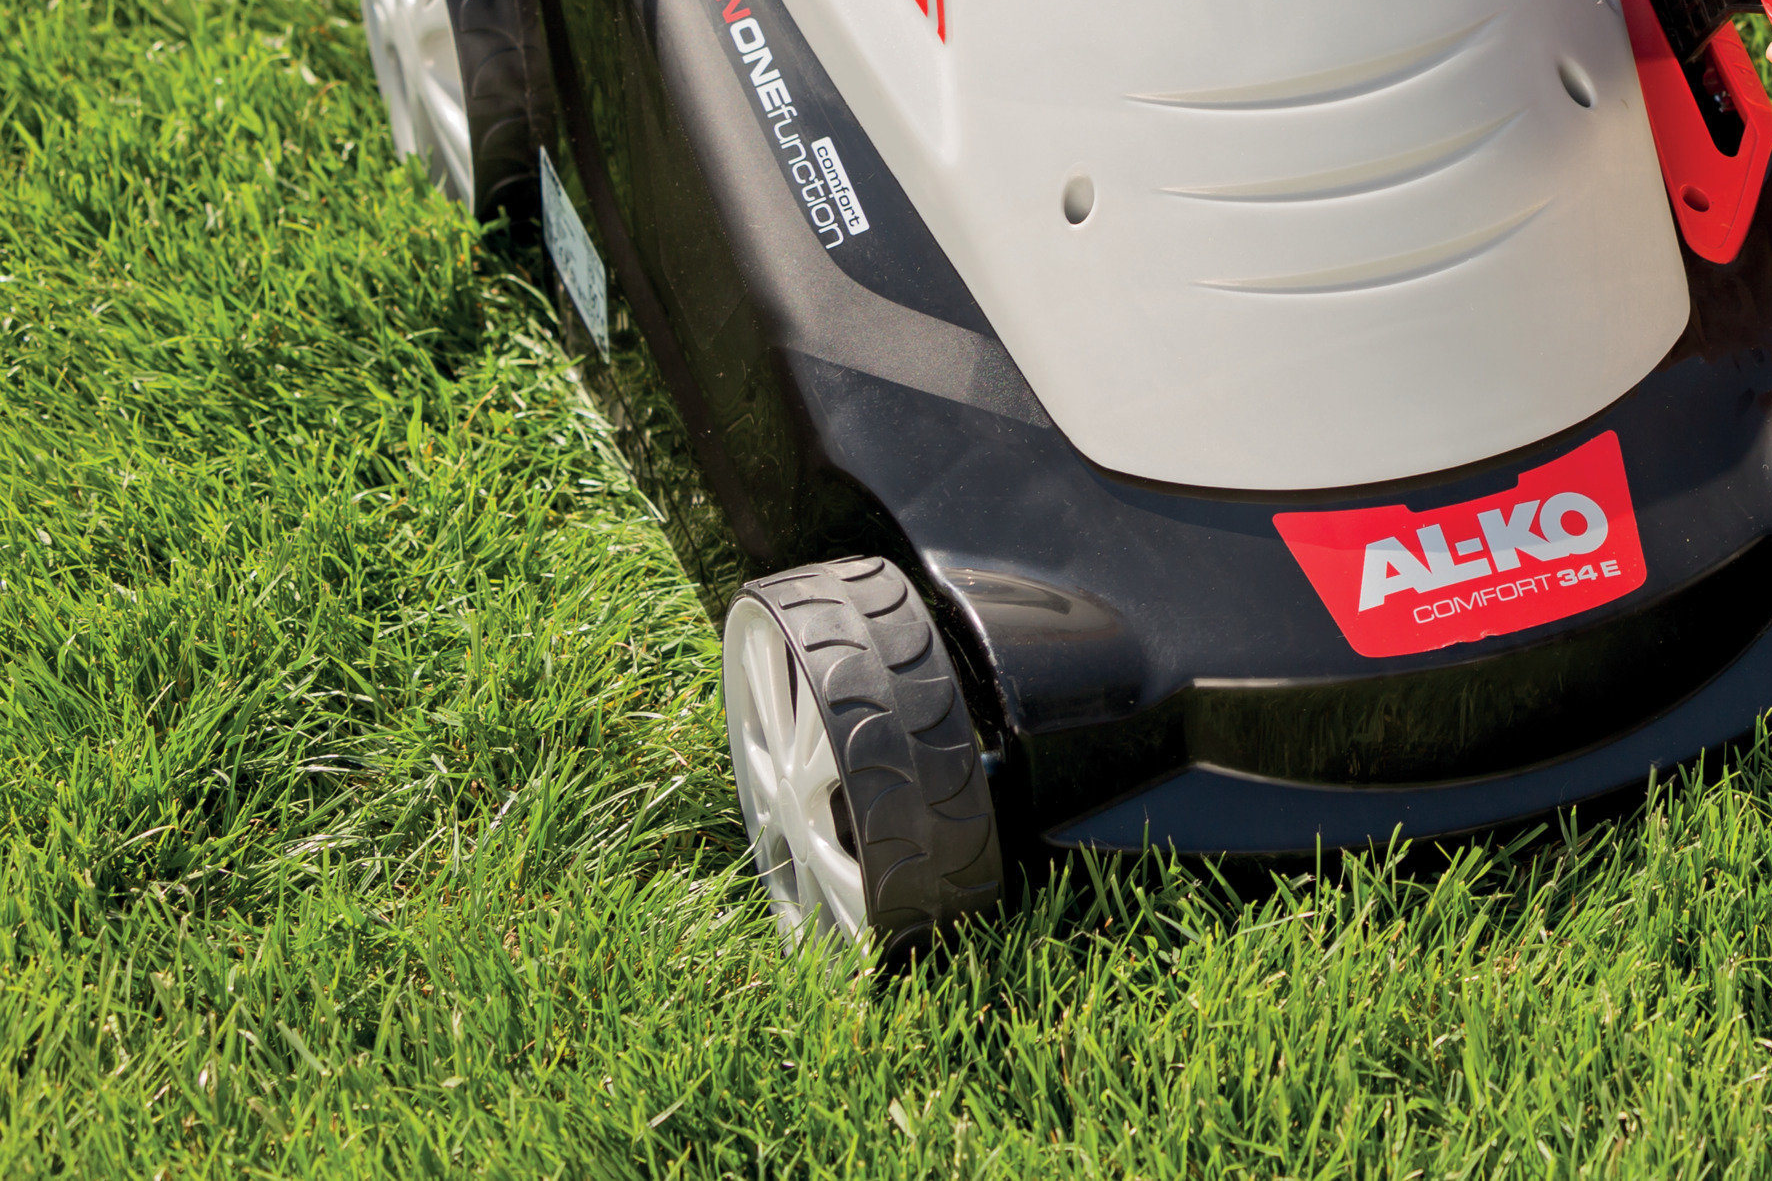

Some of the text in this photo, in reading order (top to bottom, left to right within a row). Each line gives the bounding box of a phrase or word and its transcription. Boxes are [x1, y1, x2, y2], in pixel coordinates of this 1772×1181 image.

[815, 144, 861, 228] comfort
[1358, 492, 1609, 613] AL-KO
[1413, 573, 1551, 624] COMFORT
